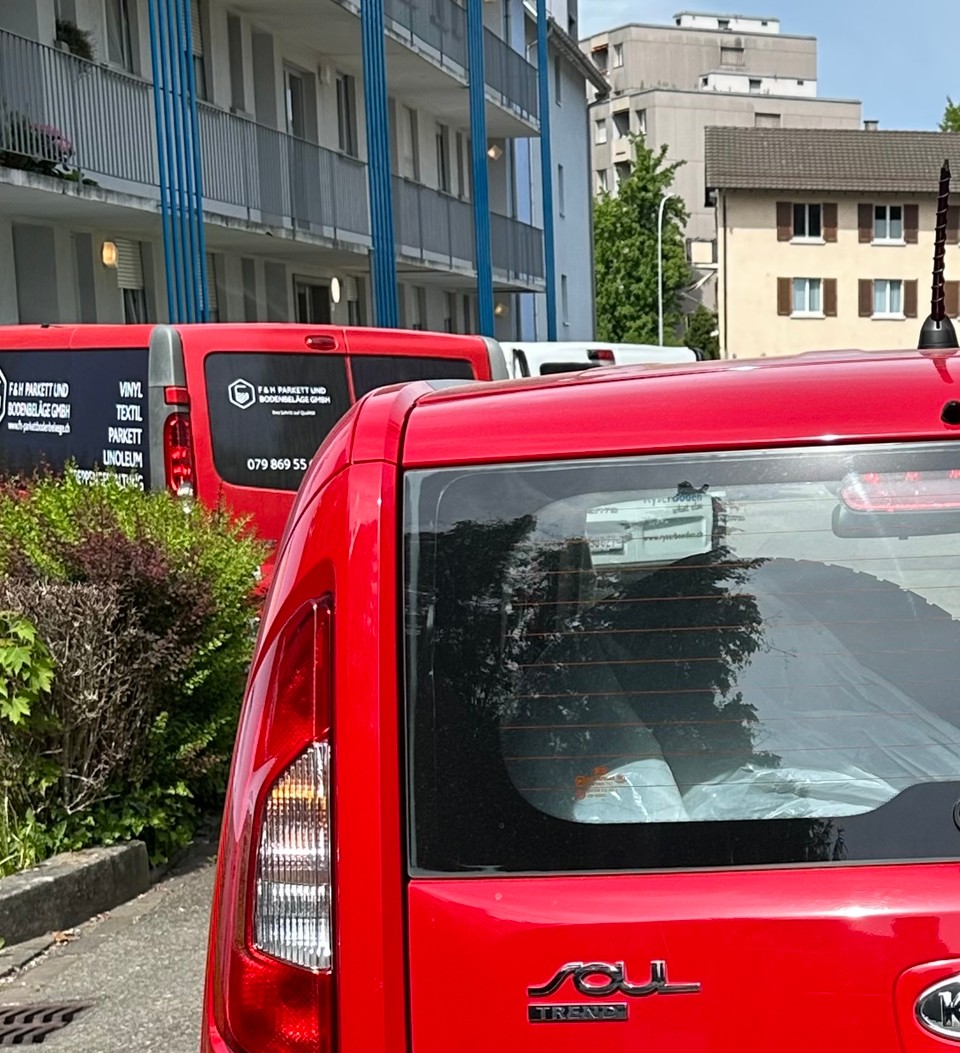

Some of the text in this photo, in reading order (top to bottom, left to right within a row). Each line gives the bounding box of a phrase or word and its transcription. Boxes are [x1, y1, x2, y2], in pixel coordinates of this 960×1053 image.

[25, 382, 53, 397] PARKETT
[53, 383, 69, 398] UND
[119, 381, 143, 398] VINYL
[277, 386, 309, 394] PARKETT
[51, 403, 71, 418] GMBH
[116, 404, 143, 421] TEXTIL
[108, 427, 143, 444] PARKETT
[103, 449, 143, 468] LINOLEUM
[247, 458, 268, 470] 079
[270, 458, 291, 470] 869
[293, 458, 307, 470] 55
[527, 960, 700, 997] SOUL
[535, 1005, 619, 1020] TREND
